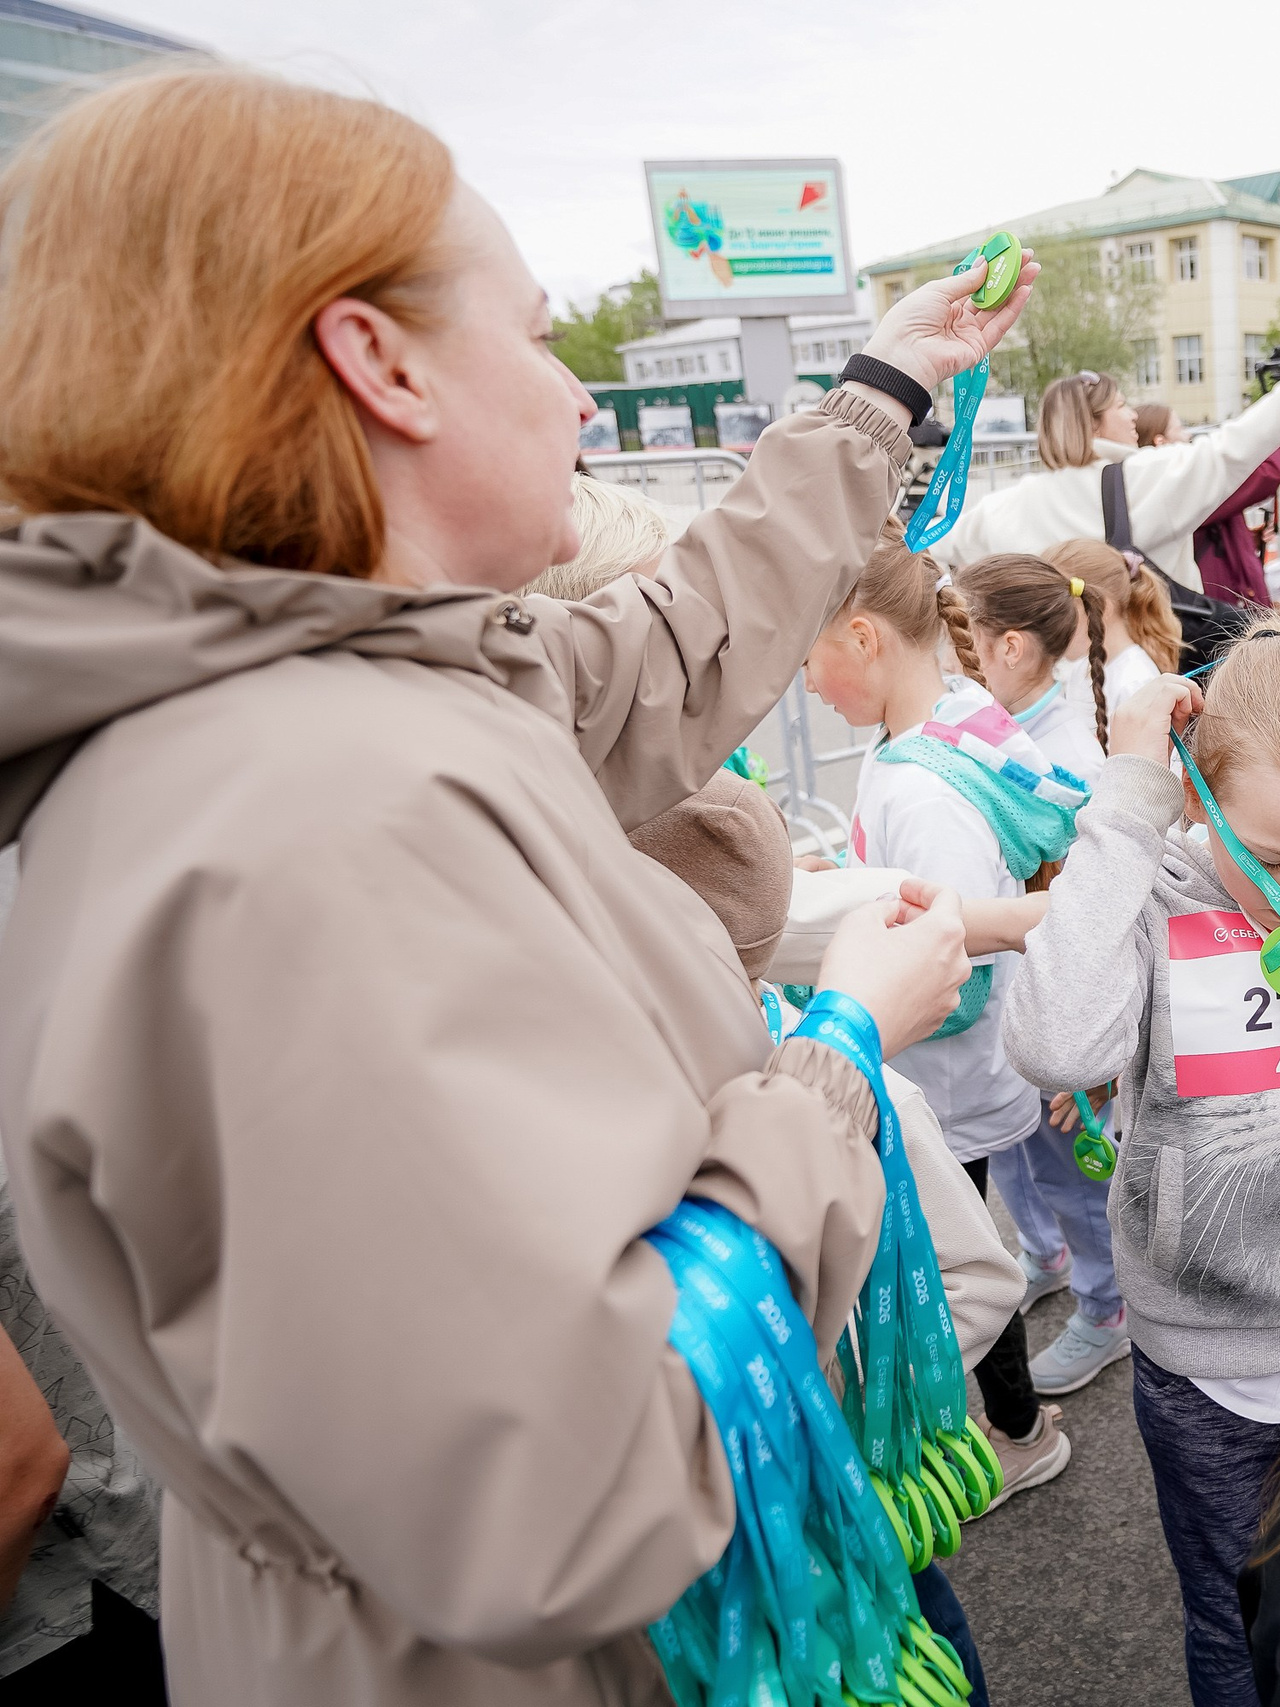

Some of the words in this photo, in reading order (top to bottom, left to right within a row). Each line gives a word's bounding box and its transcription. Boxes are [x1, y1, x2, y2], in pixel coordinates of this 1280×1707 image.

[932, 469, 949, 496] 2026
[1205, 798, 1224, 828] 2026
[1230, 929, 1261, 940] СБЕР
[884, 1110, 895, 1157] 2026
[912, 1266, 930, 1306] 2026
[878, 1284, 891, 1325] 2026
